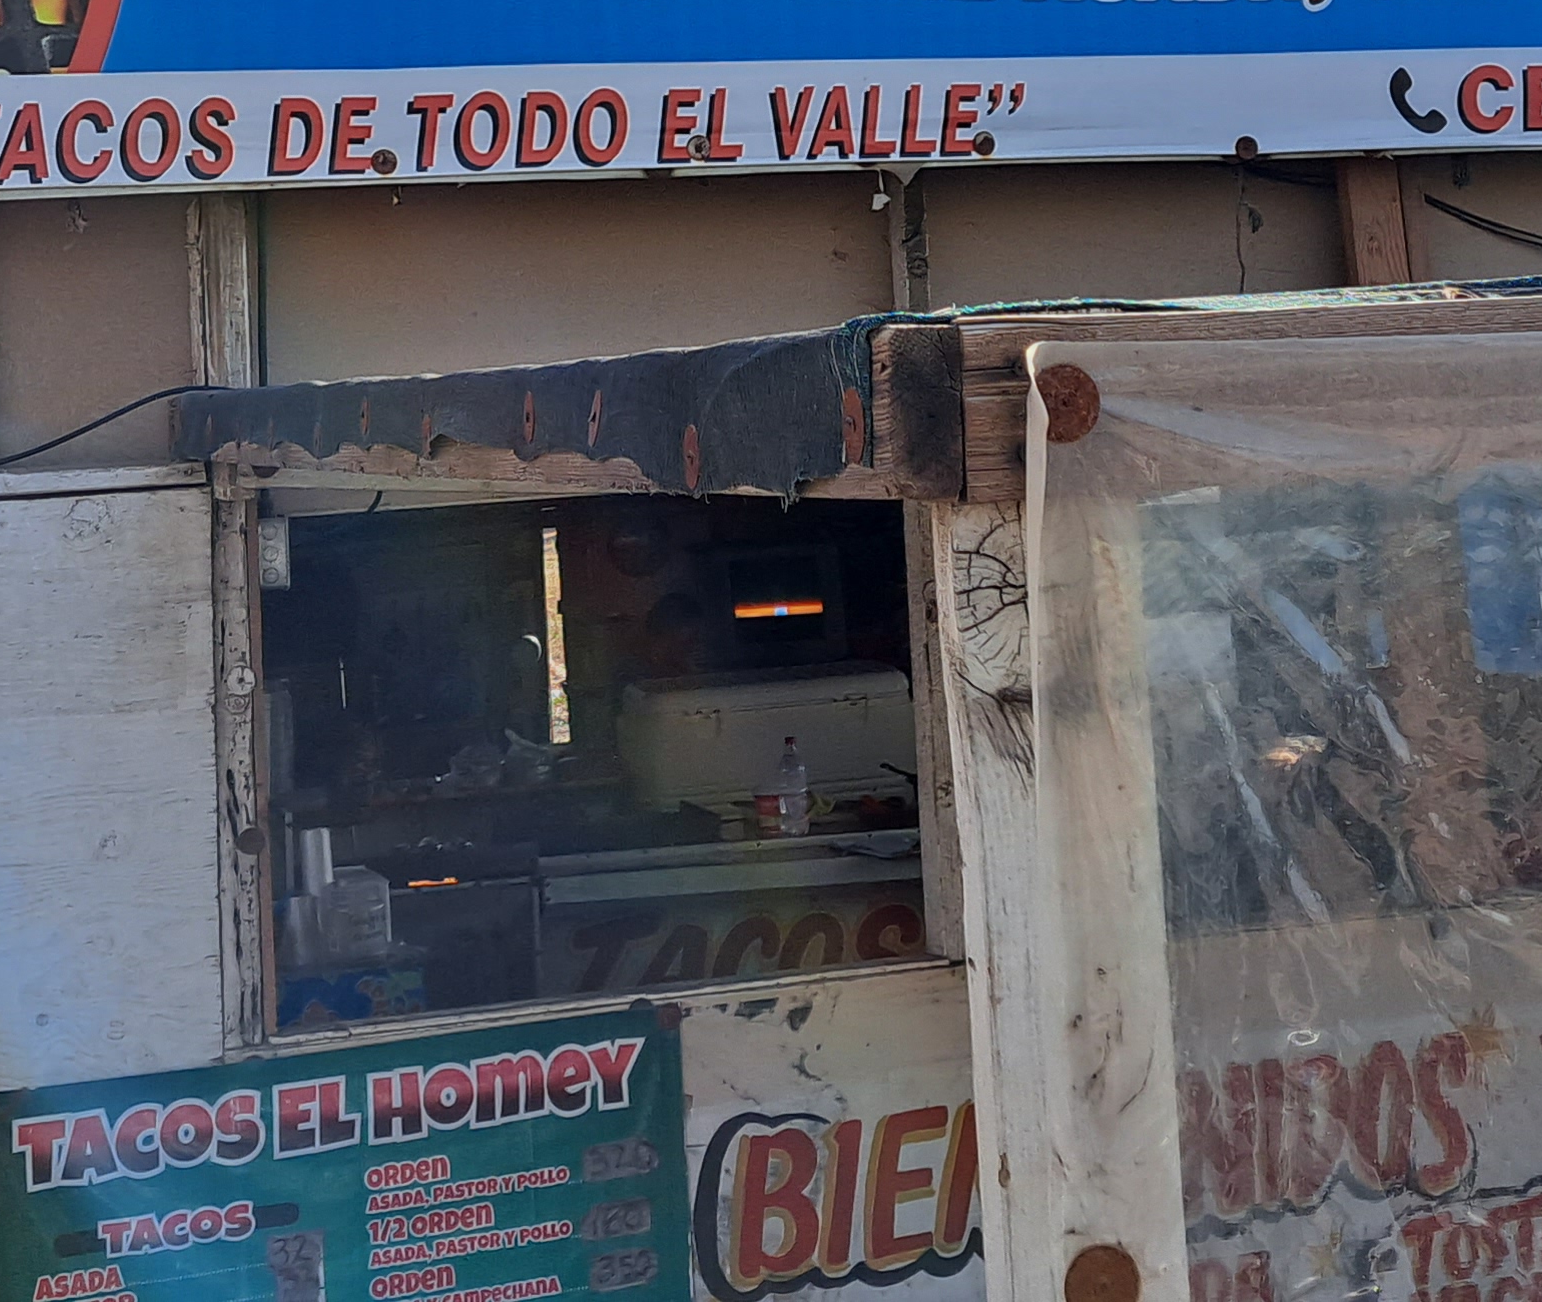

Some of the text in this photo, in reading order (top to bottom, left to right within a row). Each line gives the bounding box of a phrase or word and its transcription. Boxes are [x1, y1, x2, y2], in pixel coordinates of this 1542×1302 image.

[267, 96, 378, 176] DE
[407, 86, 629, 172] TODO
[658, 86, 744, 164] EL
[572, 905, 923, 995] TACOS
[11, 1089, 266, 1194] TACOS
[272, 1075, 361, 1160] EL
[433, 1179, 500, 1205] PASTOR
[499, 1176, 514, 1195] Y
[516, 1166, 569, 1189] POLLO
[97, 1201, 255, 1258] TACOS
[368, 1216, 408, 1244] 1/2
[435, 1234, 502, 1260] PASTOR
[502, 1230, 518, 1248] Y
[519, 1221, 573, 1245] POLLO
[34, 1265, 124, 1301] ASADA
